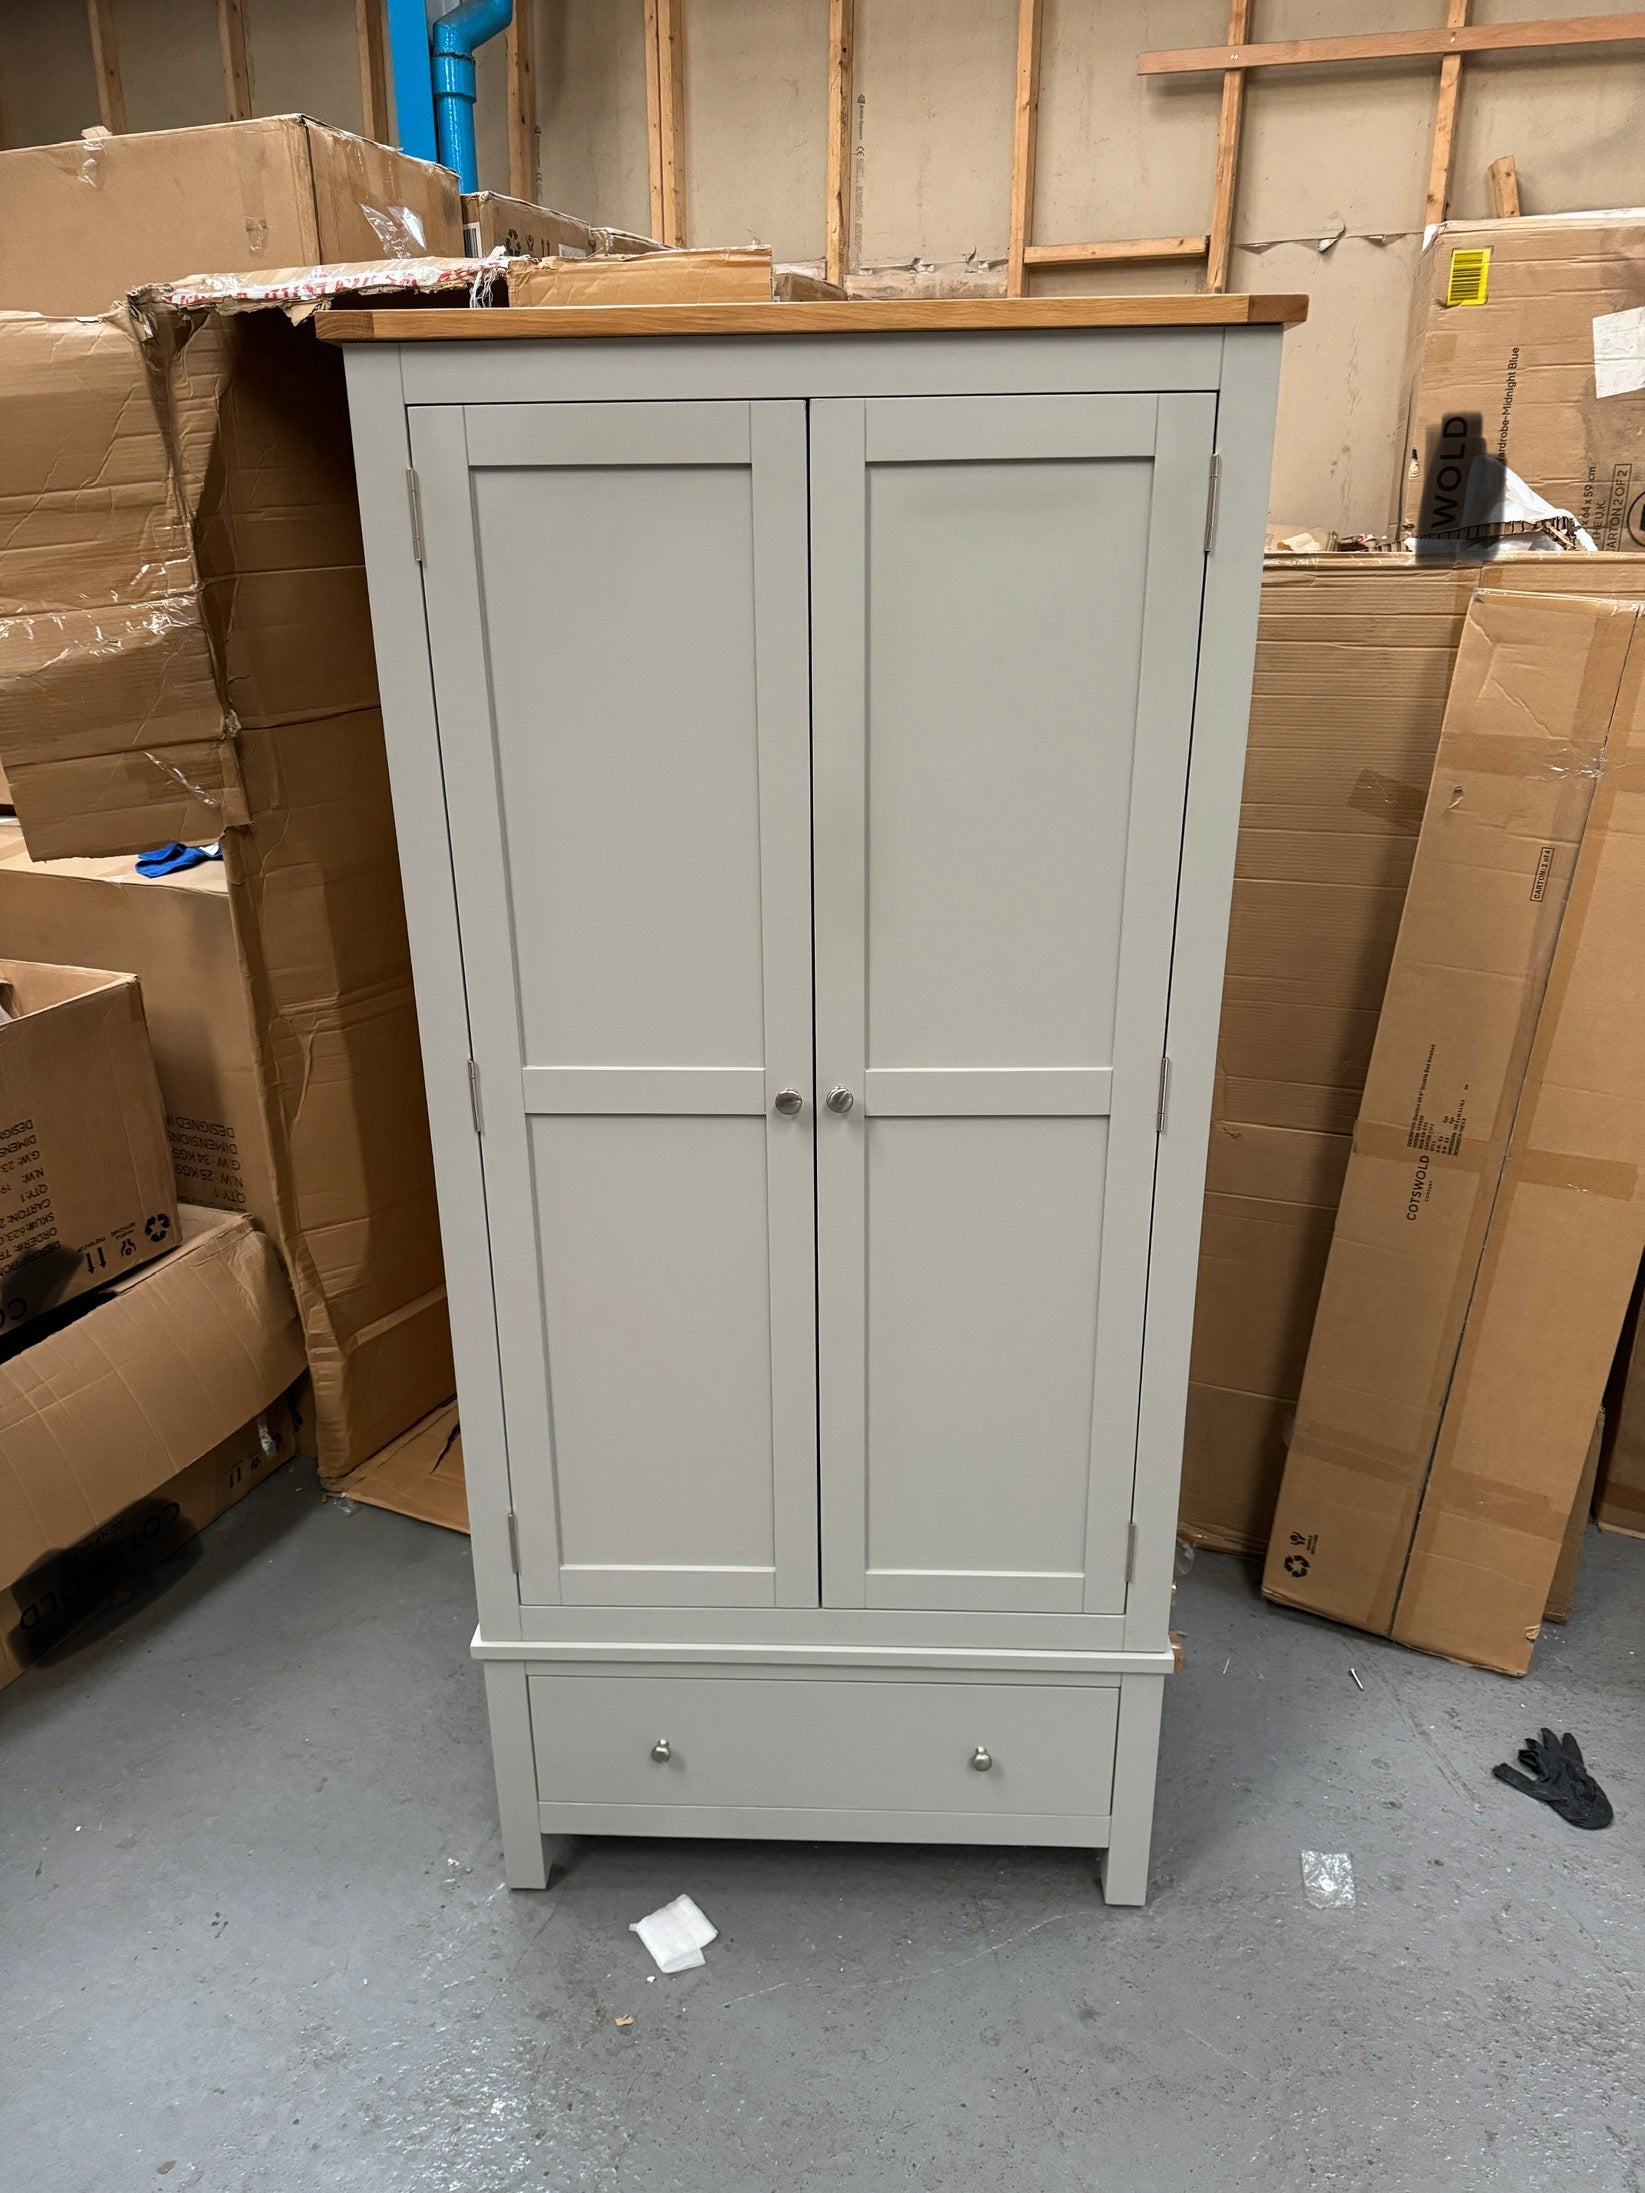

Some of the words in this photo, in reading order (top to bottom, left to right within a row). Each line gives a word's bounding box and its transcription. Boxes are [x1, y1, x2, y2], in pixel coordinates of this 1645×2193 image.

[1508, 347, 1520, 370] Blue
[1588, 466, 1597, 481] cm
[1584, 484, 1594, 497] 59
[1614, 480, 1625, 496] OF
[1581, 506, 1590, 518] 64
[176, 1117, 235, 1139] DESIGNED
[197, 1153, 211, 1165] 34
[200, 1169, 213, 1182] 25
[1406, 1155, 1430, 1220] COTSWOLD
[7, 1199, 51, 1223] CARTON:
